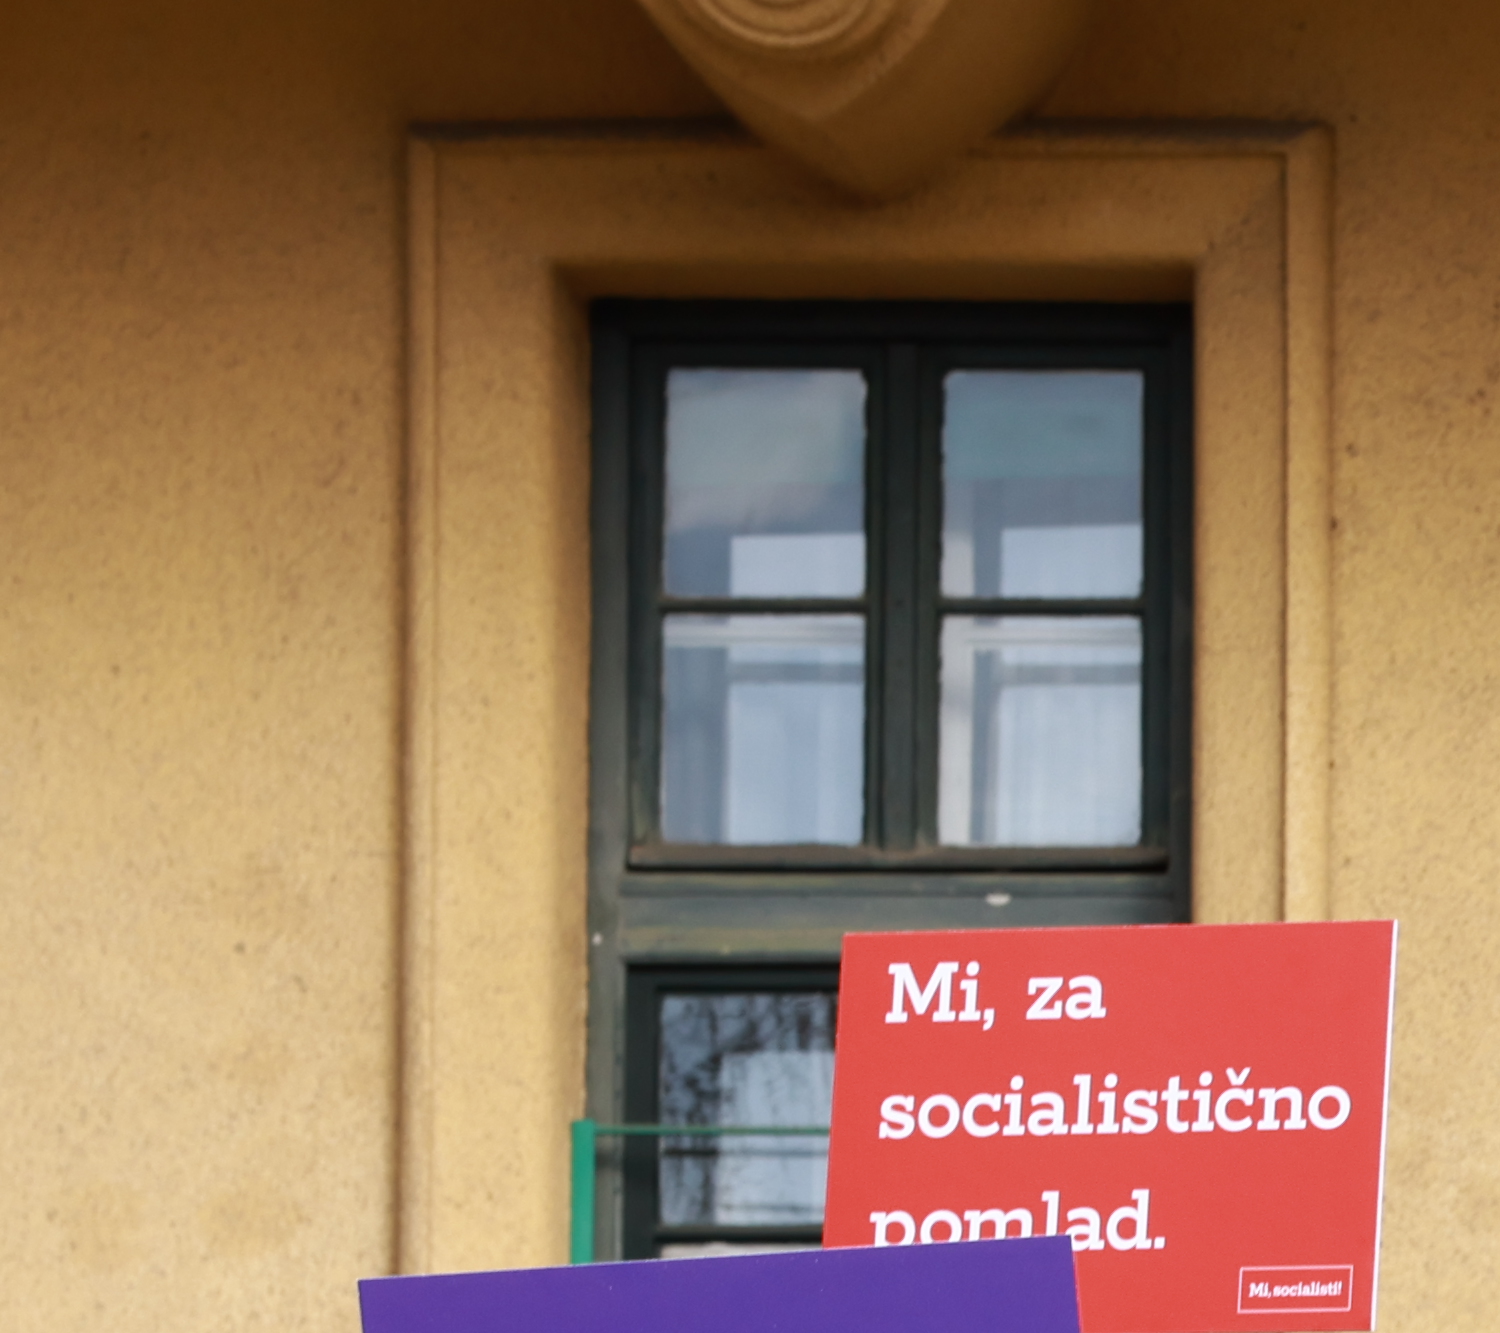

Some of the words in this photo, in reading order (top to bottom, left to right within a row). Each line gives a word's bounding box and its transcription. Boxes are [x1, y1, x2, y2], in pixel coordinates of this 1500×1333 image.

[886, 961, 994, 1030] Mi,
[1026, 976, 1106, 1019] za
[879, 1068, 1350, 1139] socialistično
[870, 1189, 1165, 1251] pomlad.
[1249, 1283, 1271, 1298] Mi,
[1273, 1281, 1342, 1296] socialisti!
